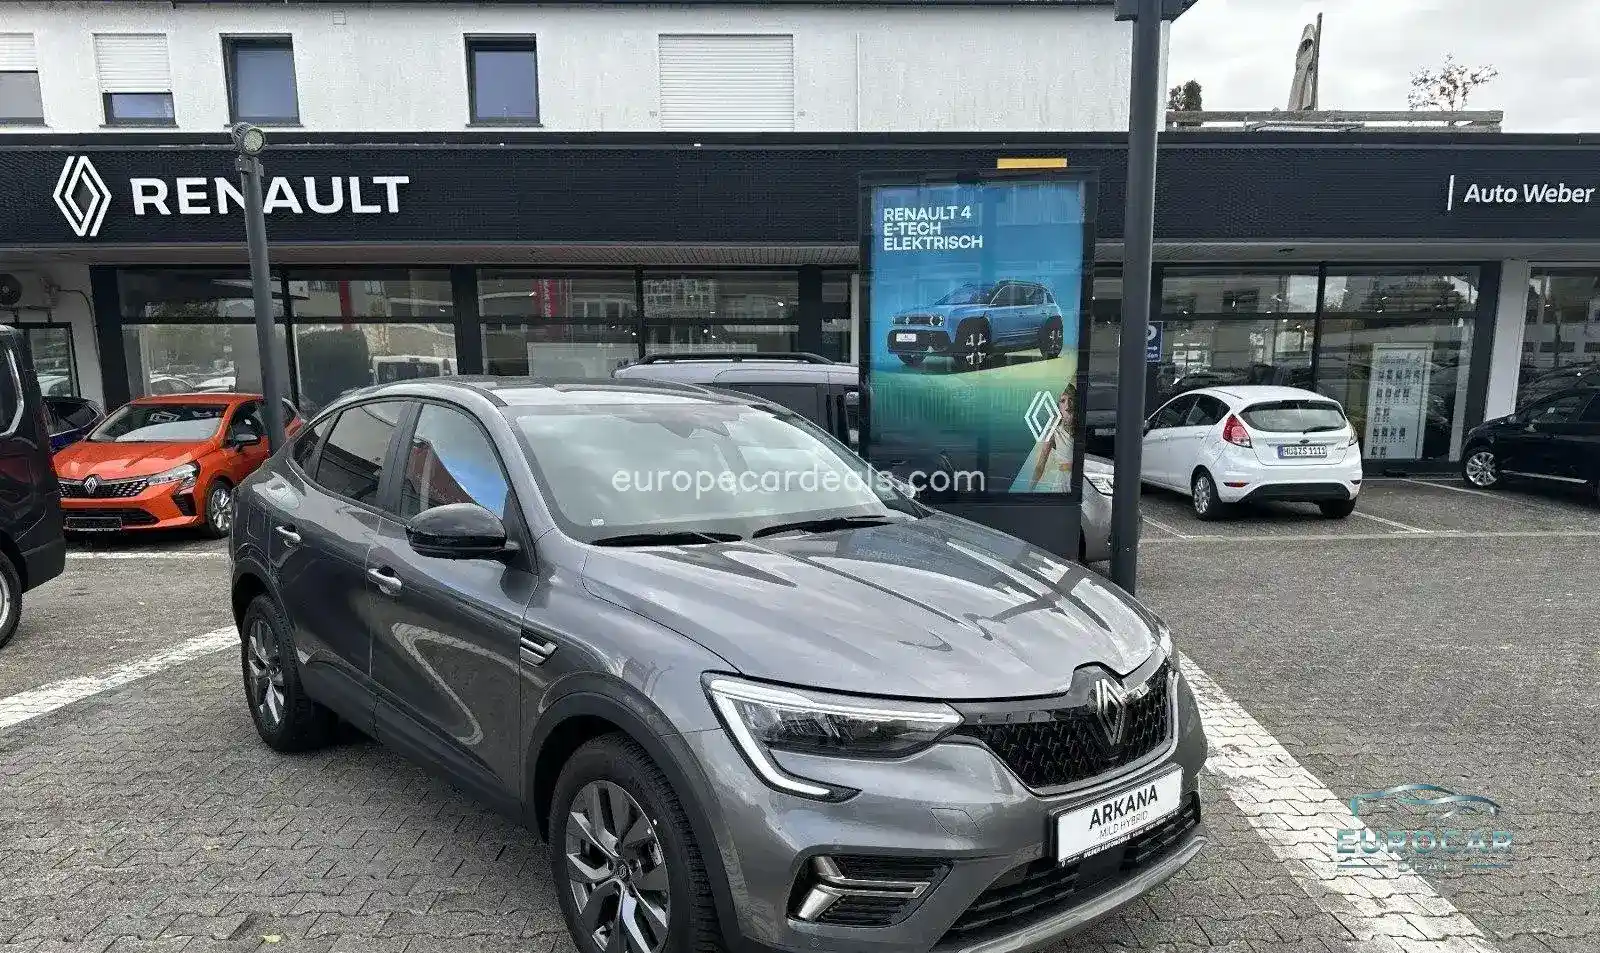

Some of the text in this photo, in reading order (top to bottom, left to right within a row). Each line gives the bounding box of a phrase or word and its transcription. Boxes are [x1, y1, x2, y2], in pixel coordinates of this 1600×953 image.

[129, 176, 410, 215] RENAULT
[1463, 182, 1596, 203] Auto Weber
[883, 205, 972, 221] RENAULT 4
[883, 221, 942, 236] E-TECH
[883, 235, 984, 251] ELEKTRISCH
[1088, 784, 1159, 830] ARKANA
[1100, 822, 1120, 838] MILD
[1120, 810, 1149, 831] HYBRID
